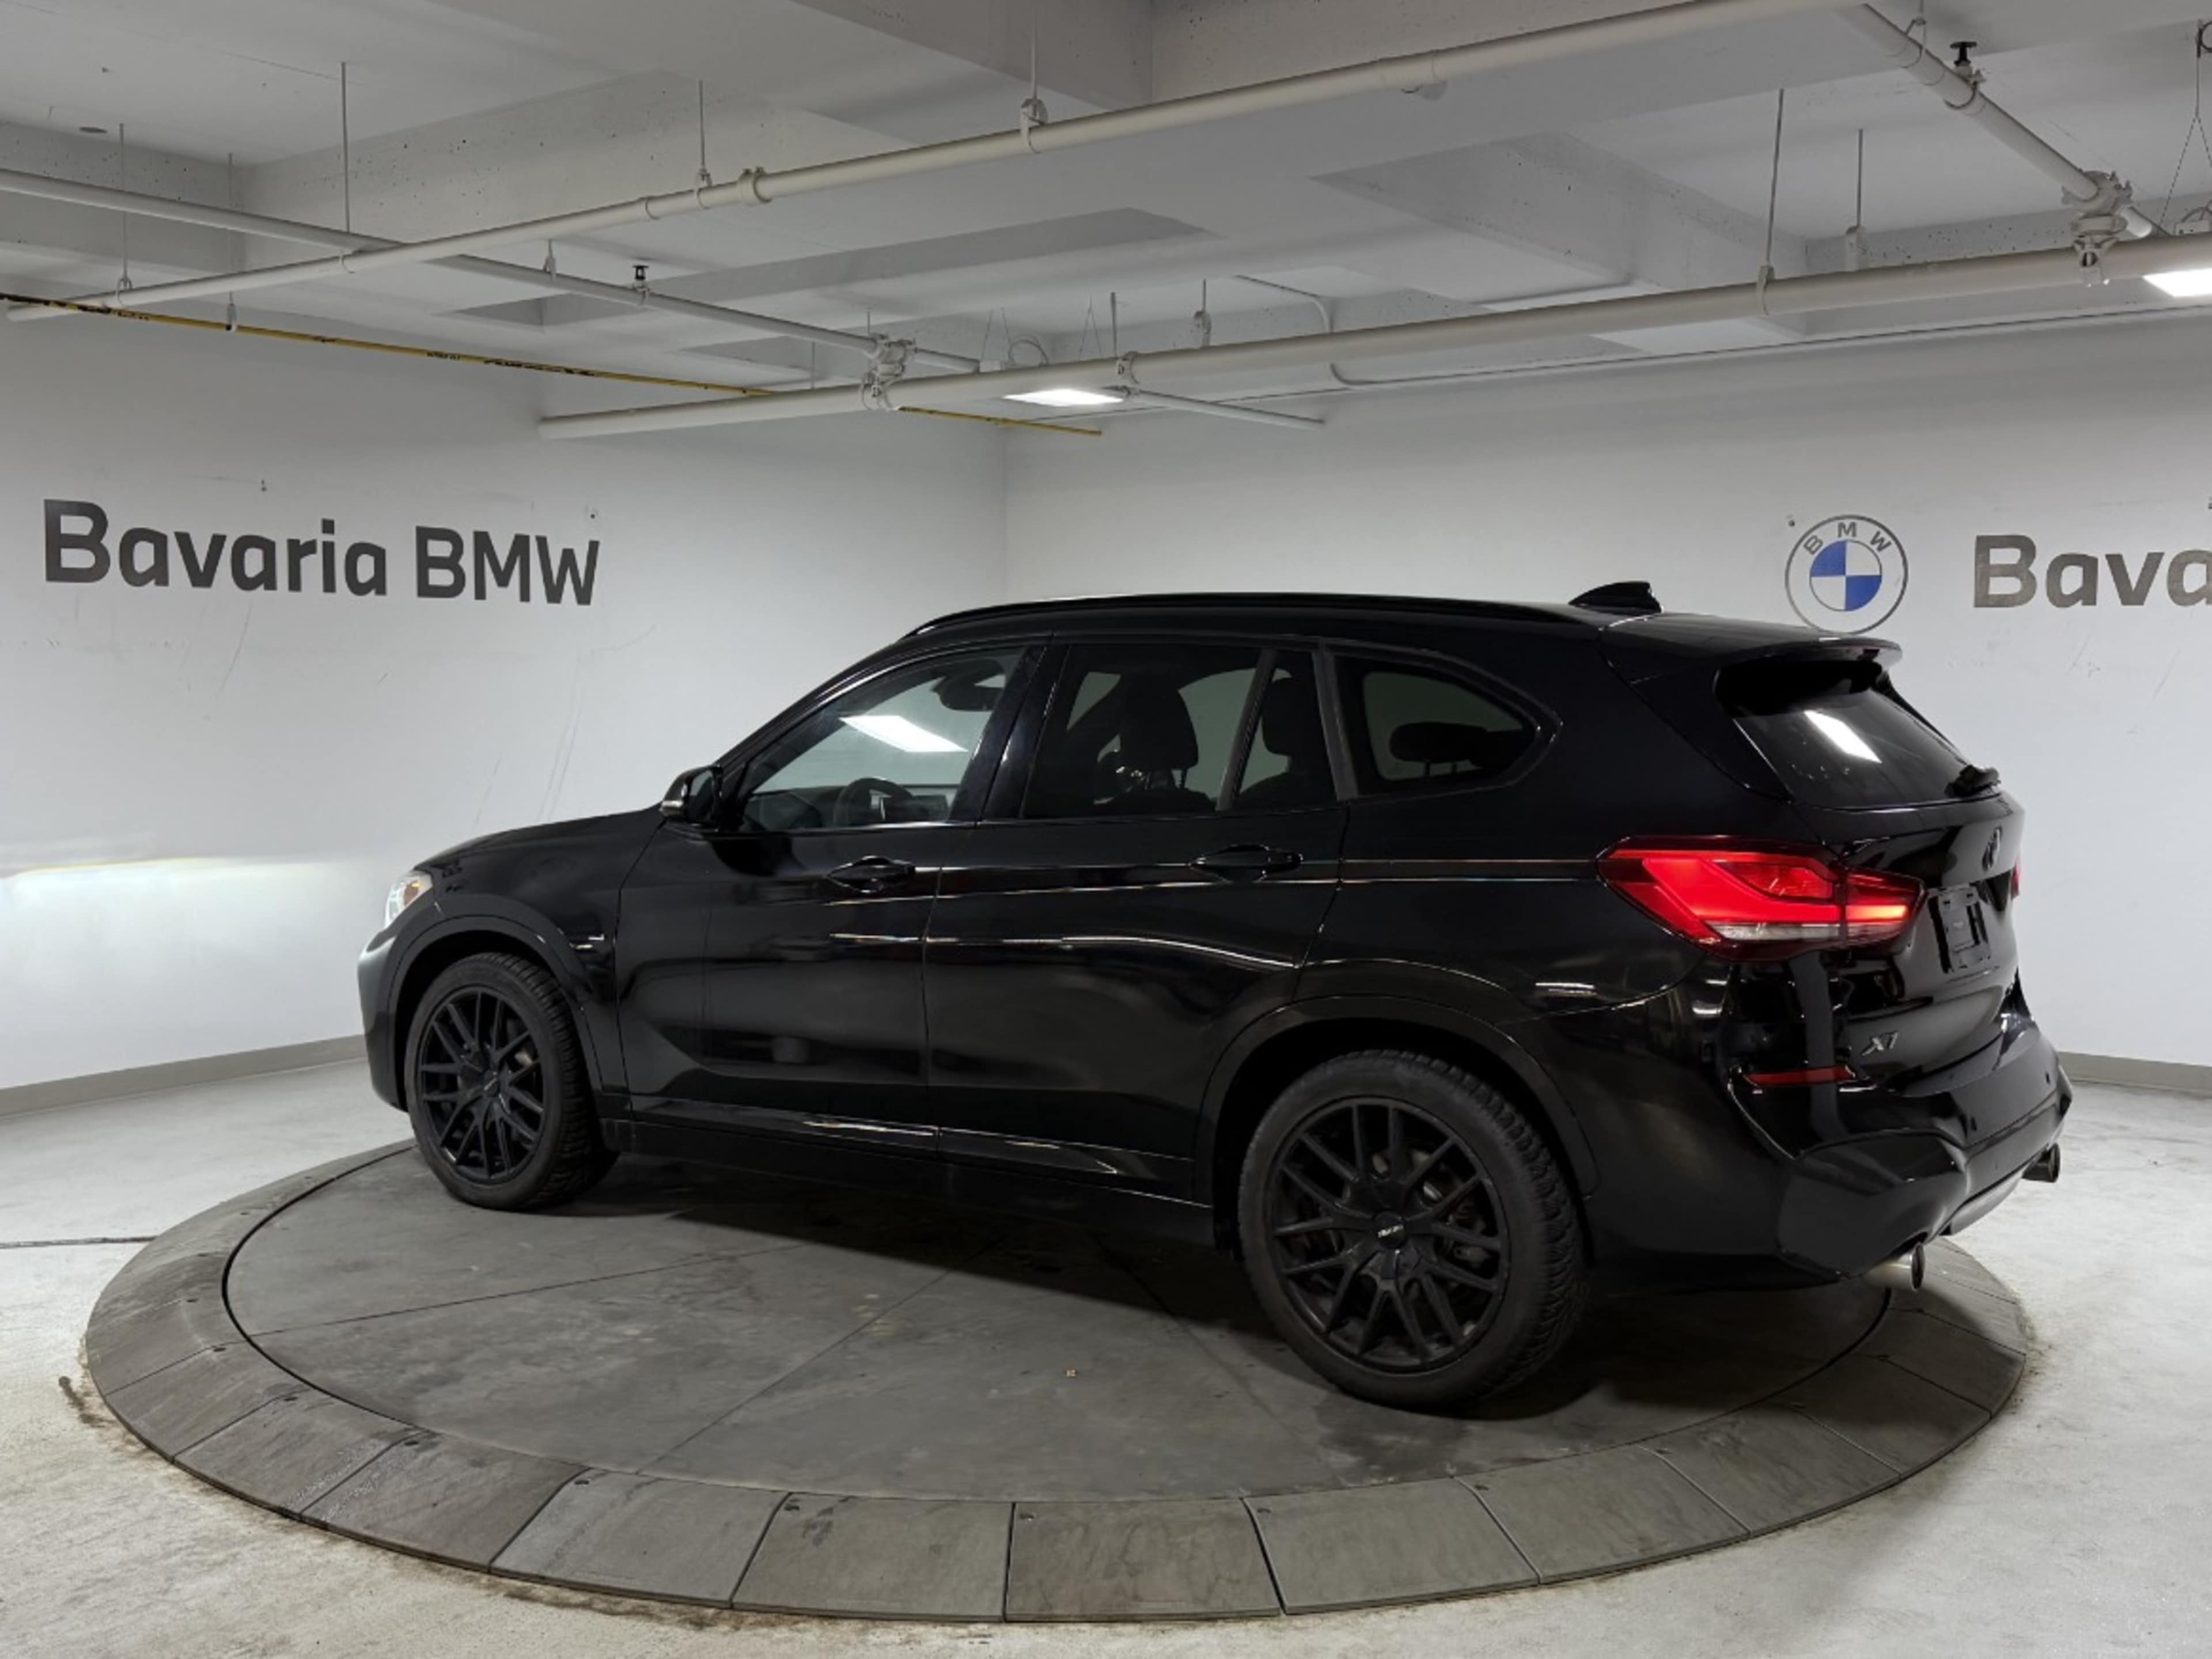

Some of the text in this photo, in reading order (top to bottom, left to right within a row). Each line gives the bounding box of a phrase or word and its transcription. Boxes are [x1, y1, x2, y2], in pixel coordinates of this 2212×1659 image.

[43, 499, 600, 605] Bavaria BMW
[1803, 521, 1892, 555] BMW
[1974, 534, 2212, 608] Bava
